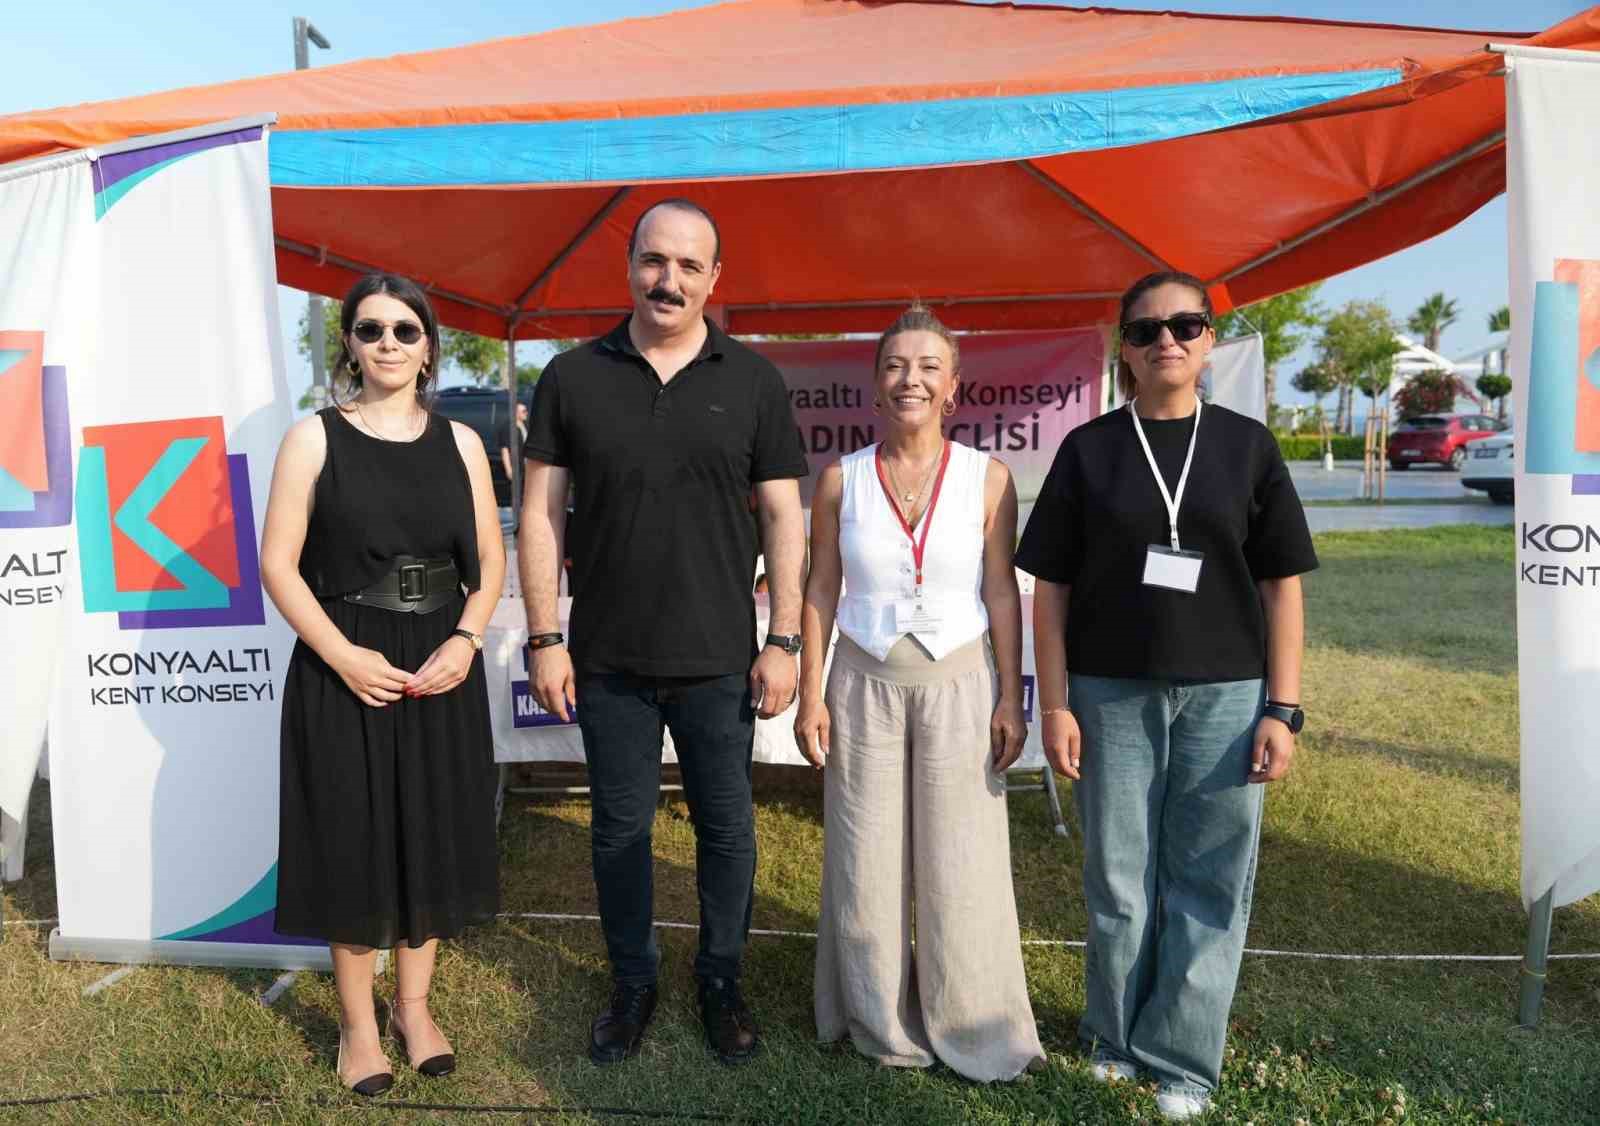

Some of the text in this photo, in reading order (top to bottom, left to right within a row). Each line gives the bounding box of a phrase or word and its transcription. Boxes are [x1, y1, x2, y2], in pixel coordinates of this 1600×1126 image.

[787, 376, 1082, 411] aaltı Konseyi
[941, 412, 1040, 451] CLİSİ
[1521, 562, 1600, 587] KENT
[88, 648, 271, 677] KONYAALTI
[91, 680, 274, 705] KENT KONSEYİ
[517, 694, 549, 717] KA
